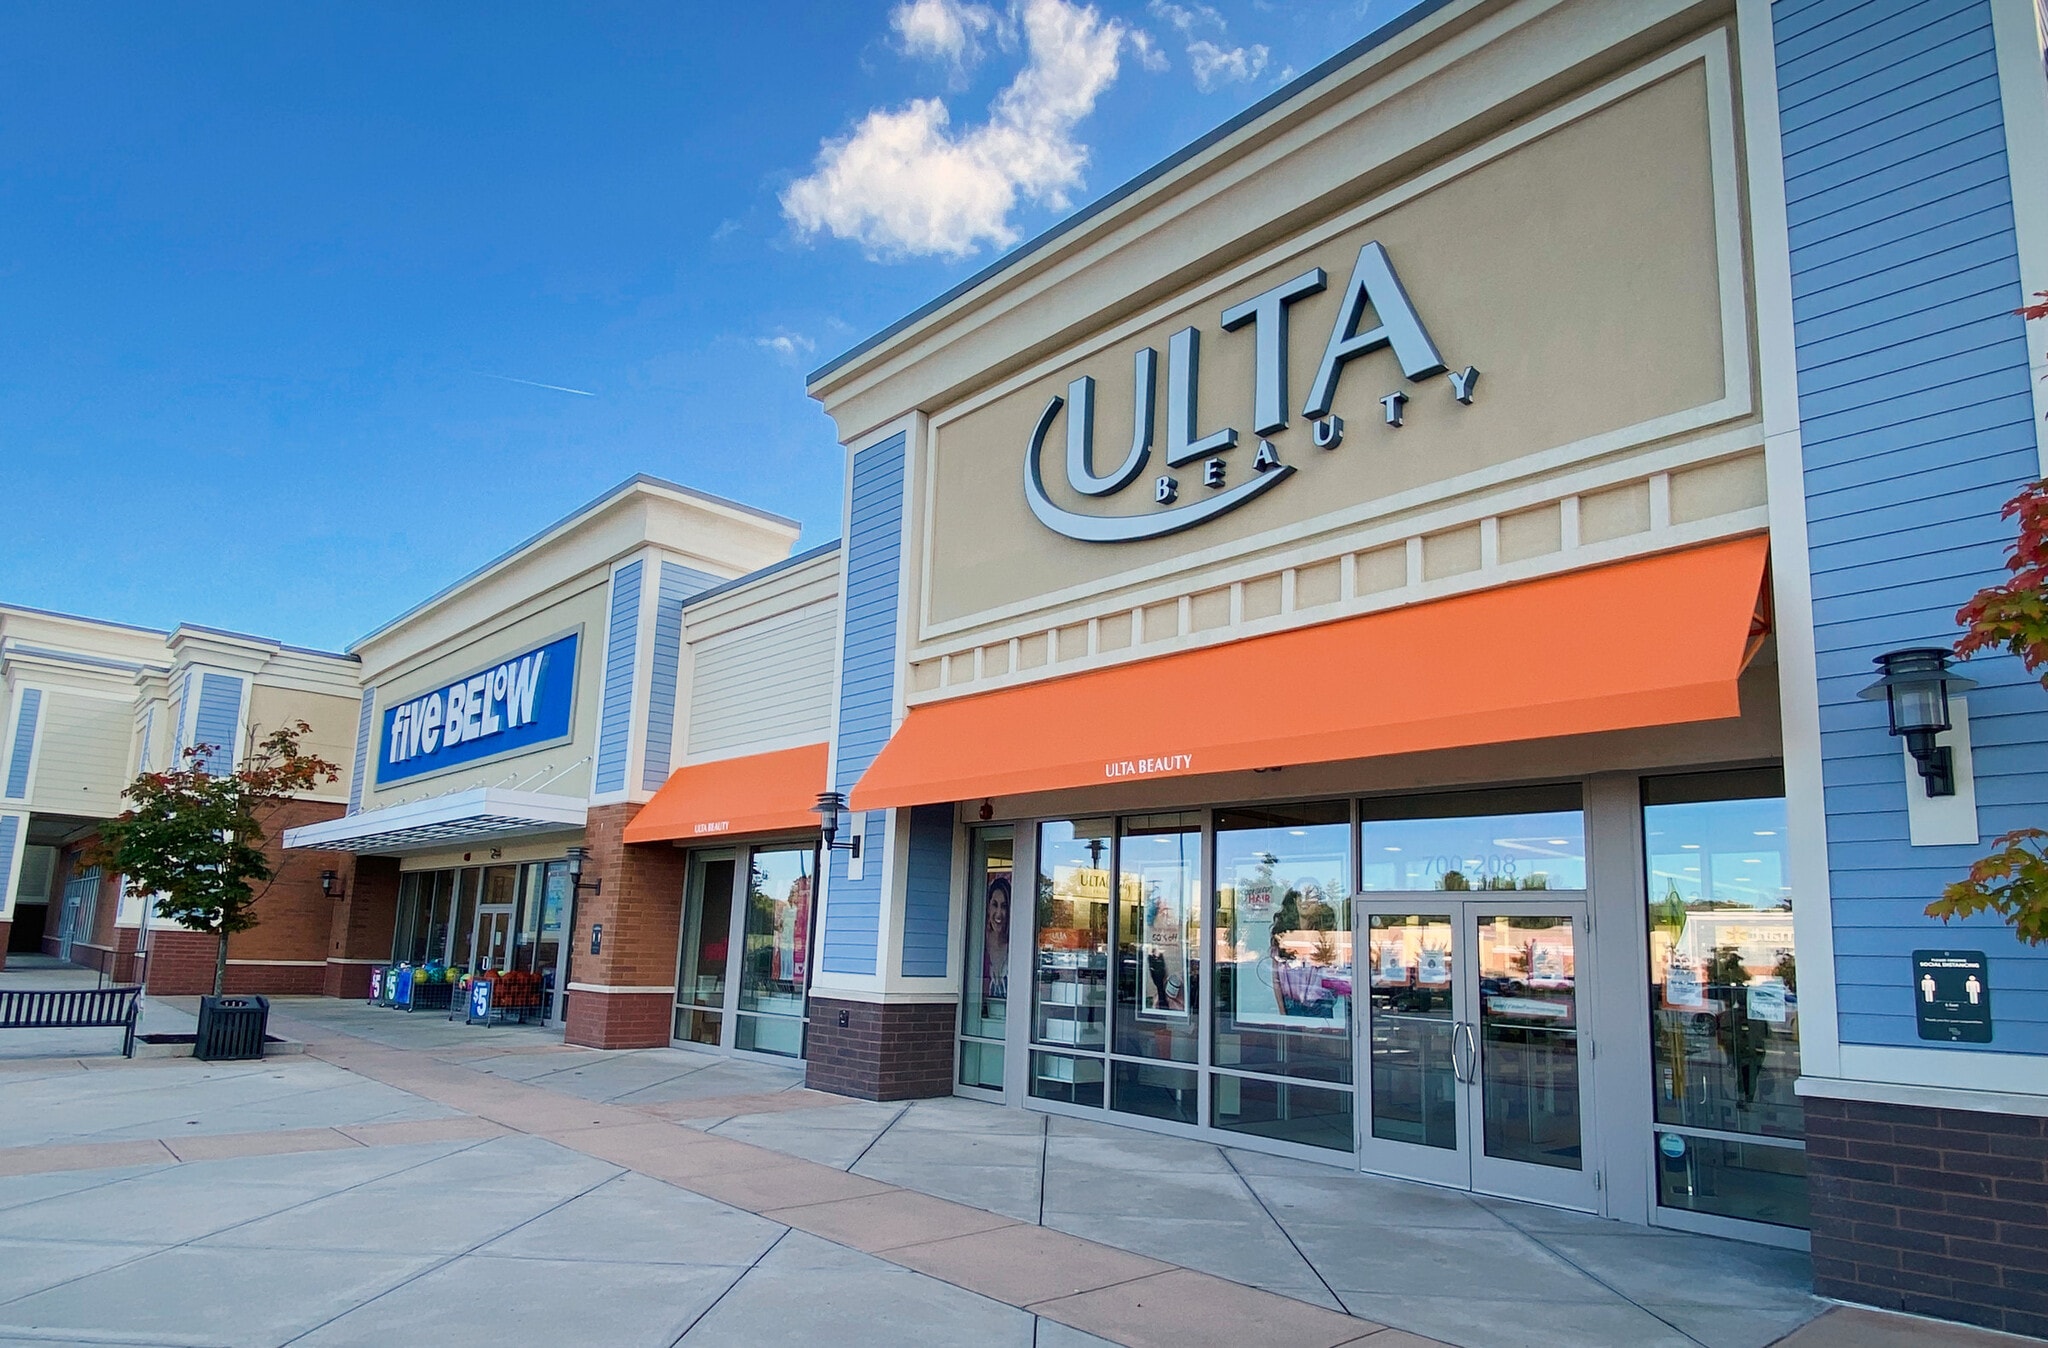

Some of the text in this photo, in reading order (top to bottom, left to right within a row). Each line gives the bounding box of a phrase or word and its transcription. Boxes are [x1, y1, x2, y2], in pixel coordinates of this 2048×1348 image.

[1067, 240, 1448, 497] ULTA
[1155, 366, 1481, 506] BEAUTY
[389, 692, 444, 764] five
[1105, 753, 1193, 778] ULTA BEAUTY
[1422, 854, 1517, 876] 700-208
[1080, 874, 1106, 888] ULTA
[1248, 893, 1271, 904] HAIR
[472, 986, 487, 1017] $5
